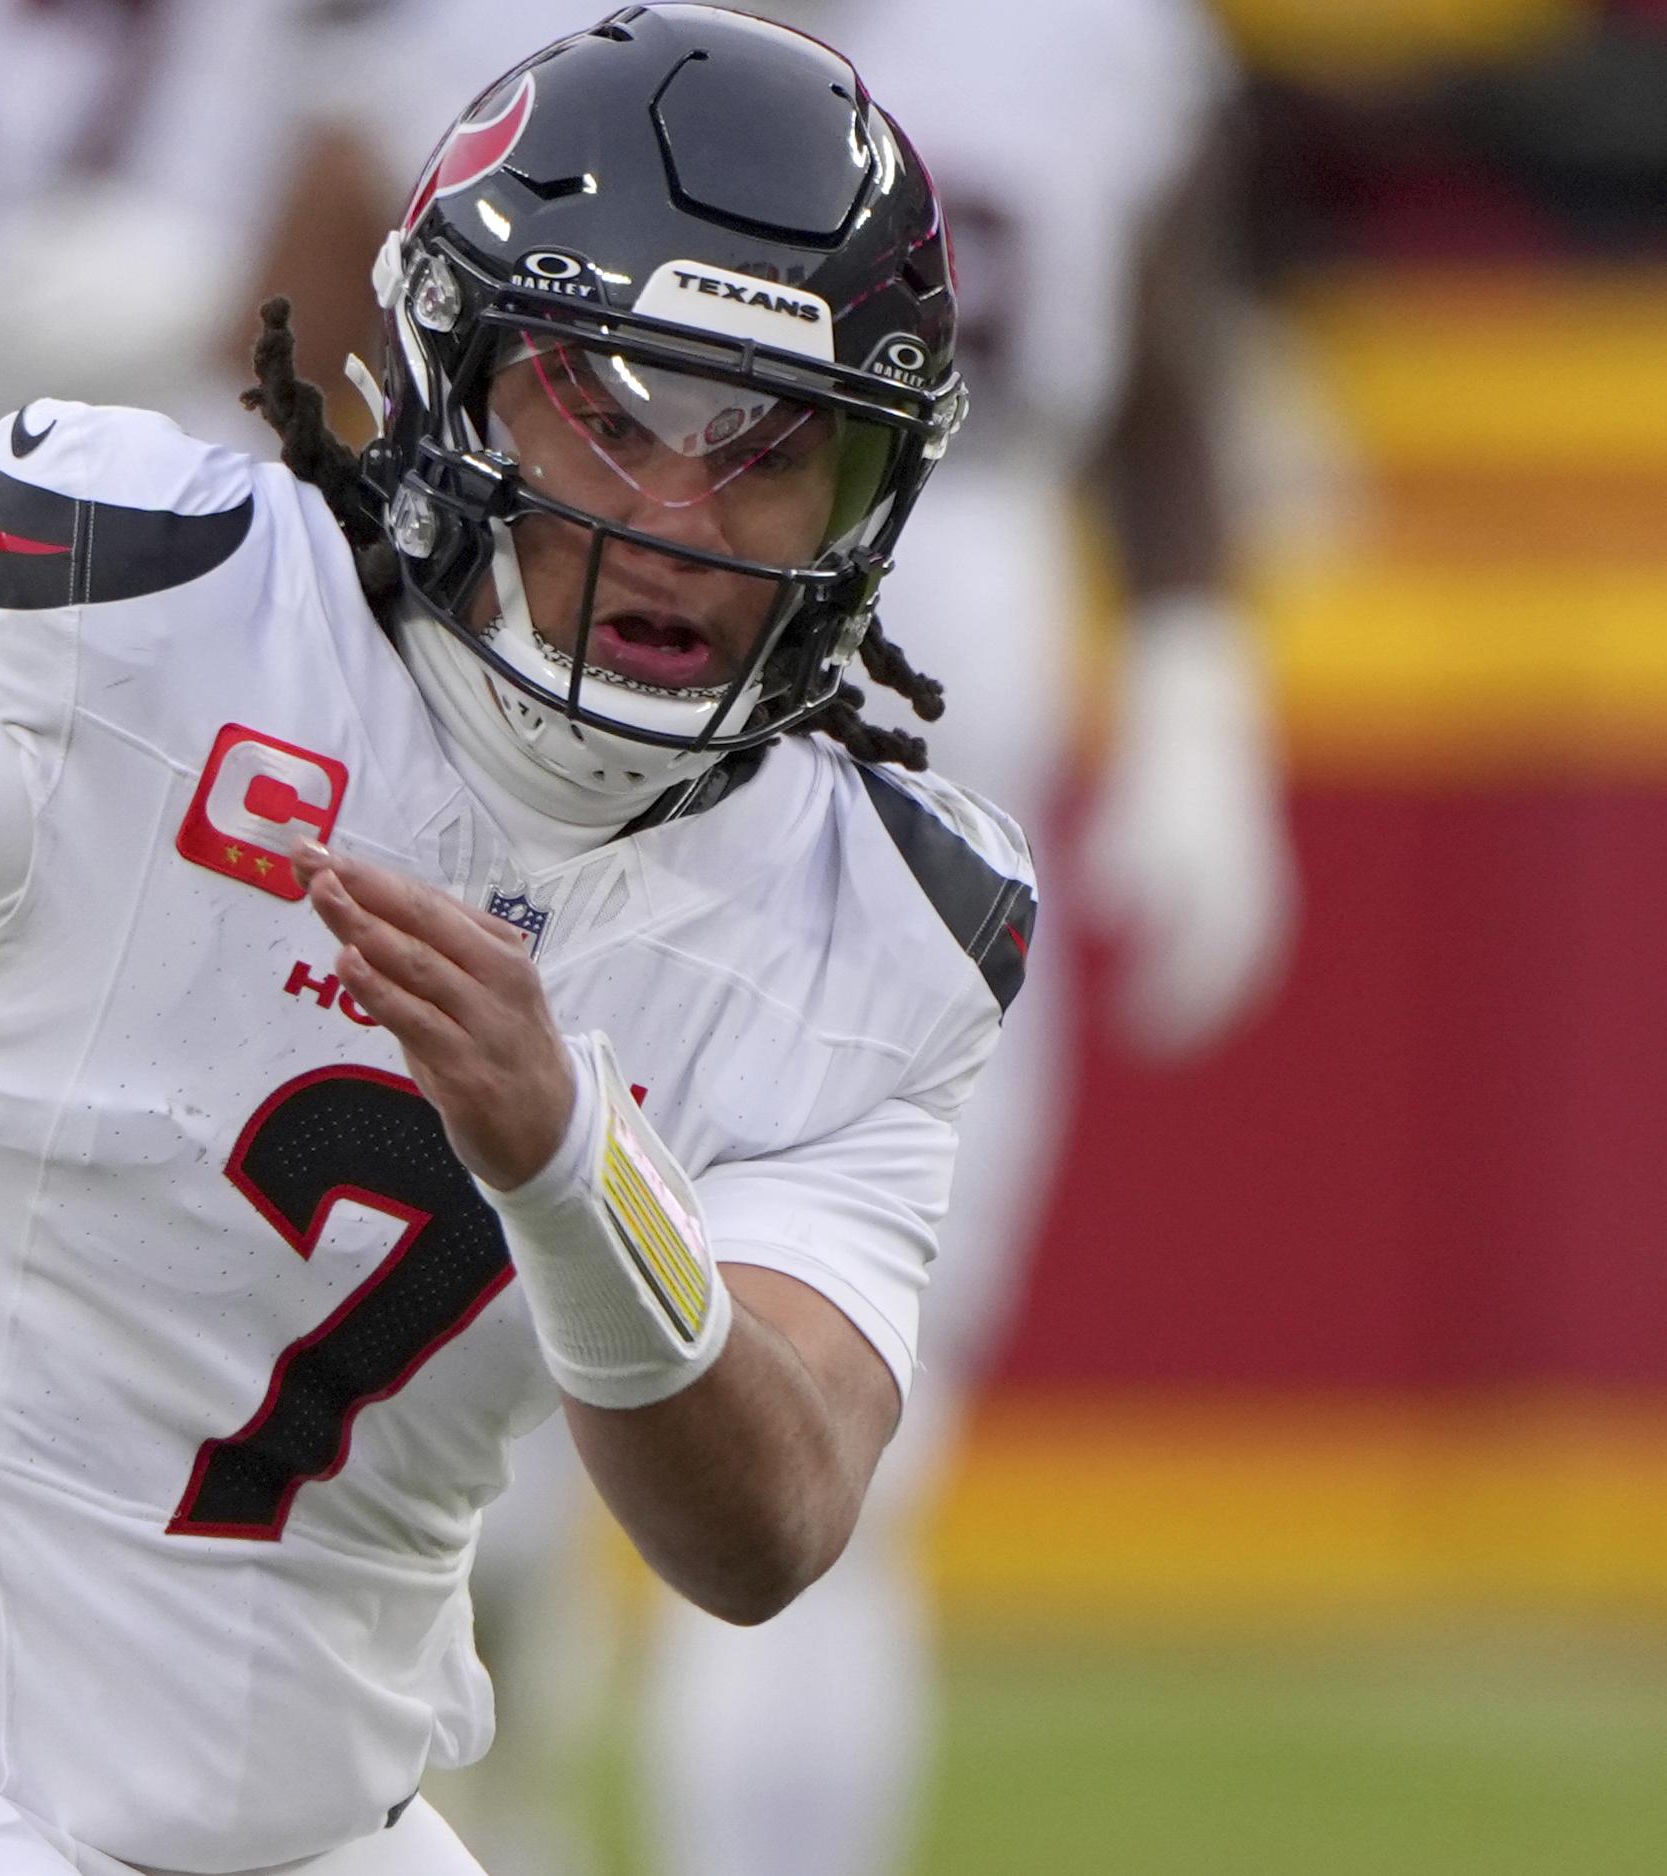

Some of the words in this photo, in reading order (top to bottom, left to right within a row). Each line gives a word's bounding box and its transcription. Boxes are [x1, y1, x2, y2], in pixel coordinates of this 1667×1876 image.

[510, 274, 593, 298] OAKLEY
[672, 270, 821, 323] TEXANS
[873, 361, 925, 388] OAKLEY
[205, 739, 332, 854] C
[164, 1062, 518, 1543] 7
